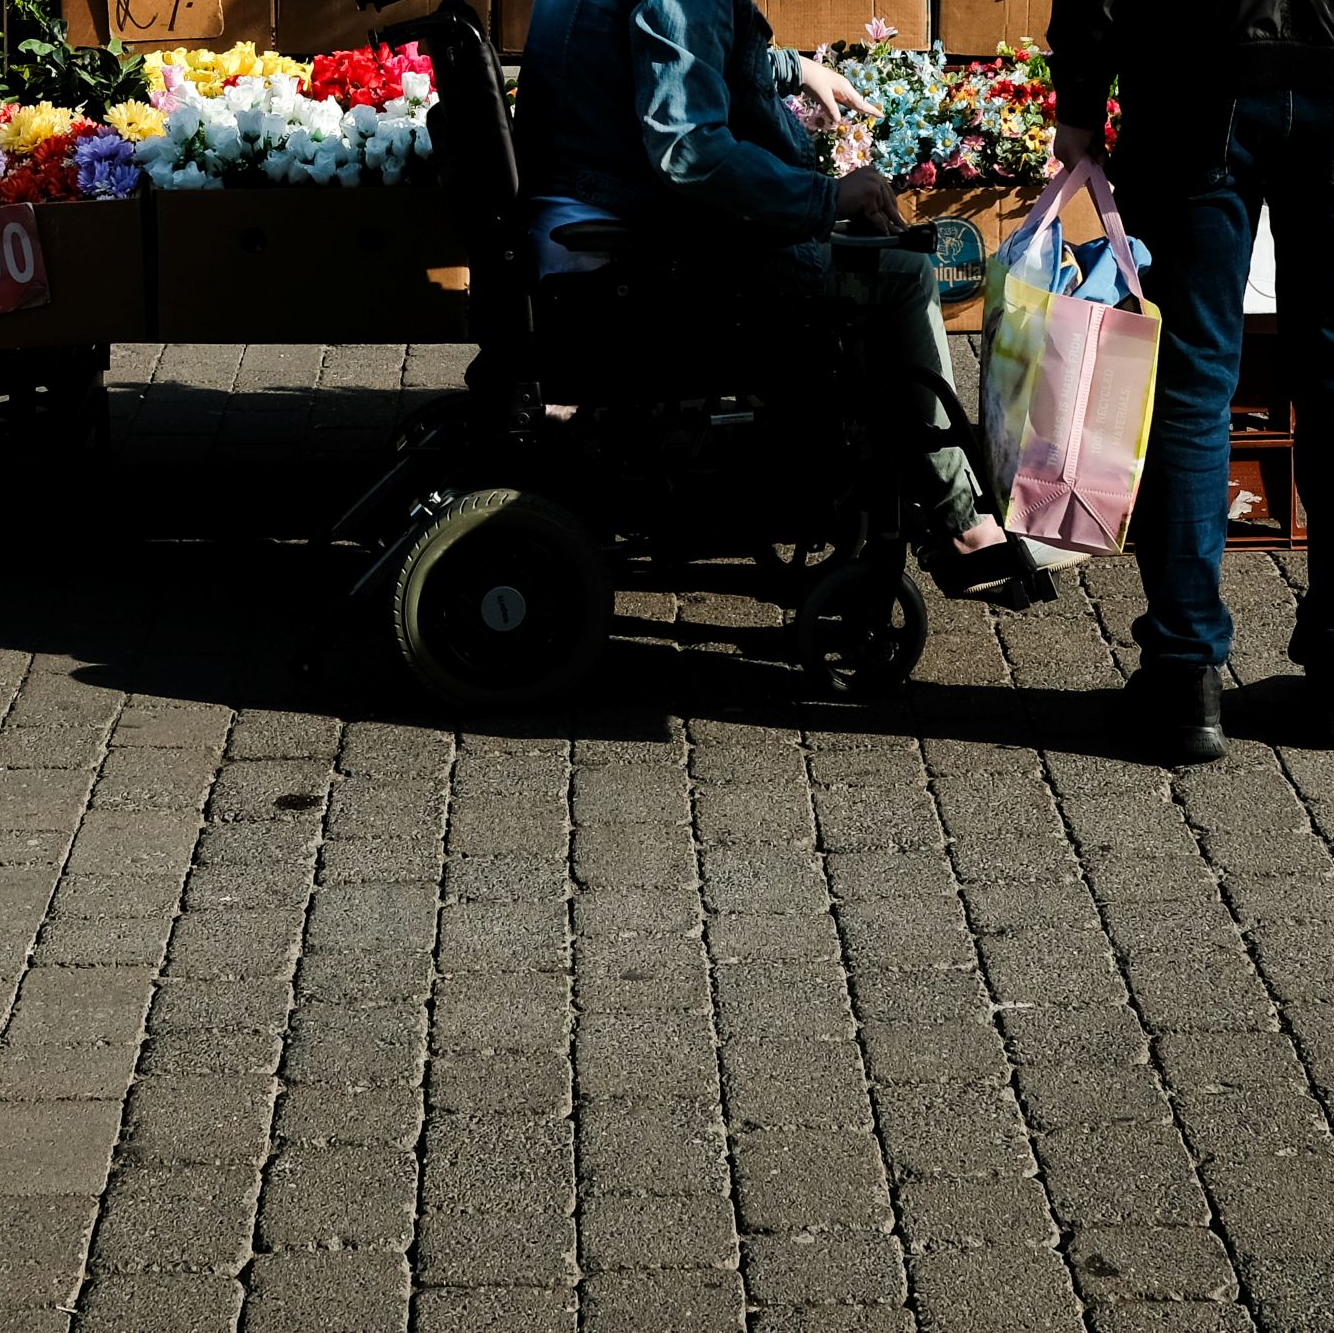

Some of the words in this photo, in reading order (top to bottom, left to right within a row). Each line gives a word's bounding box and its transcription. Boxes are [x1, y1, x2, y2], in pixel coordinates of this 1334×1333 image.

[932, 263, 982, 288] iquita
[1068, 332, 1083, 366] FROM
[1062, 366, 1076, 398] MADE
[1059, 398, 1068, 412] IS
[1095, 369, 1115, 424] RECYCLED
[1053, 415, 1064, 438] BAG
[1047, 440, 1060, 467] THIS
